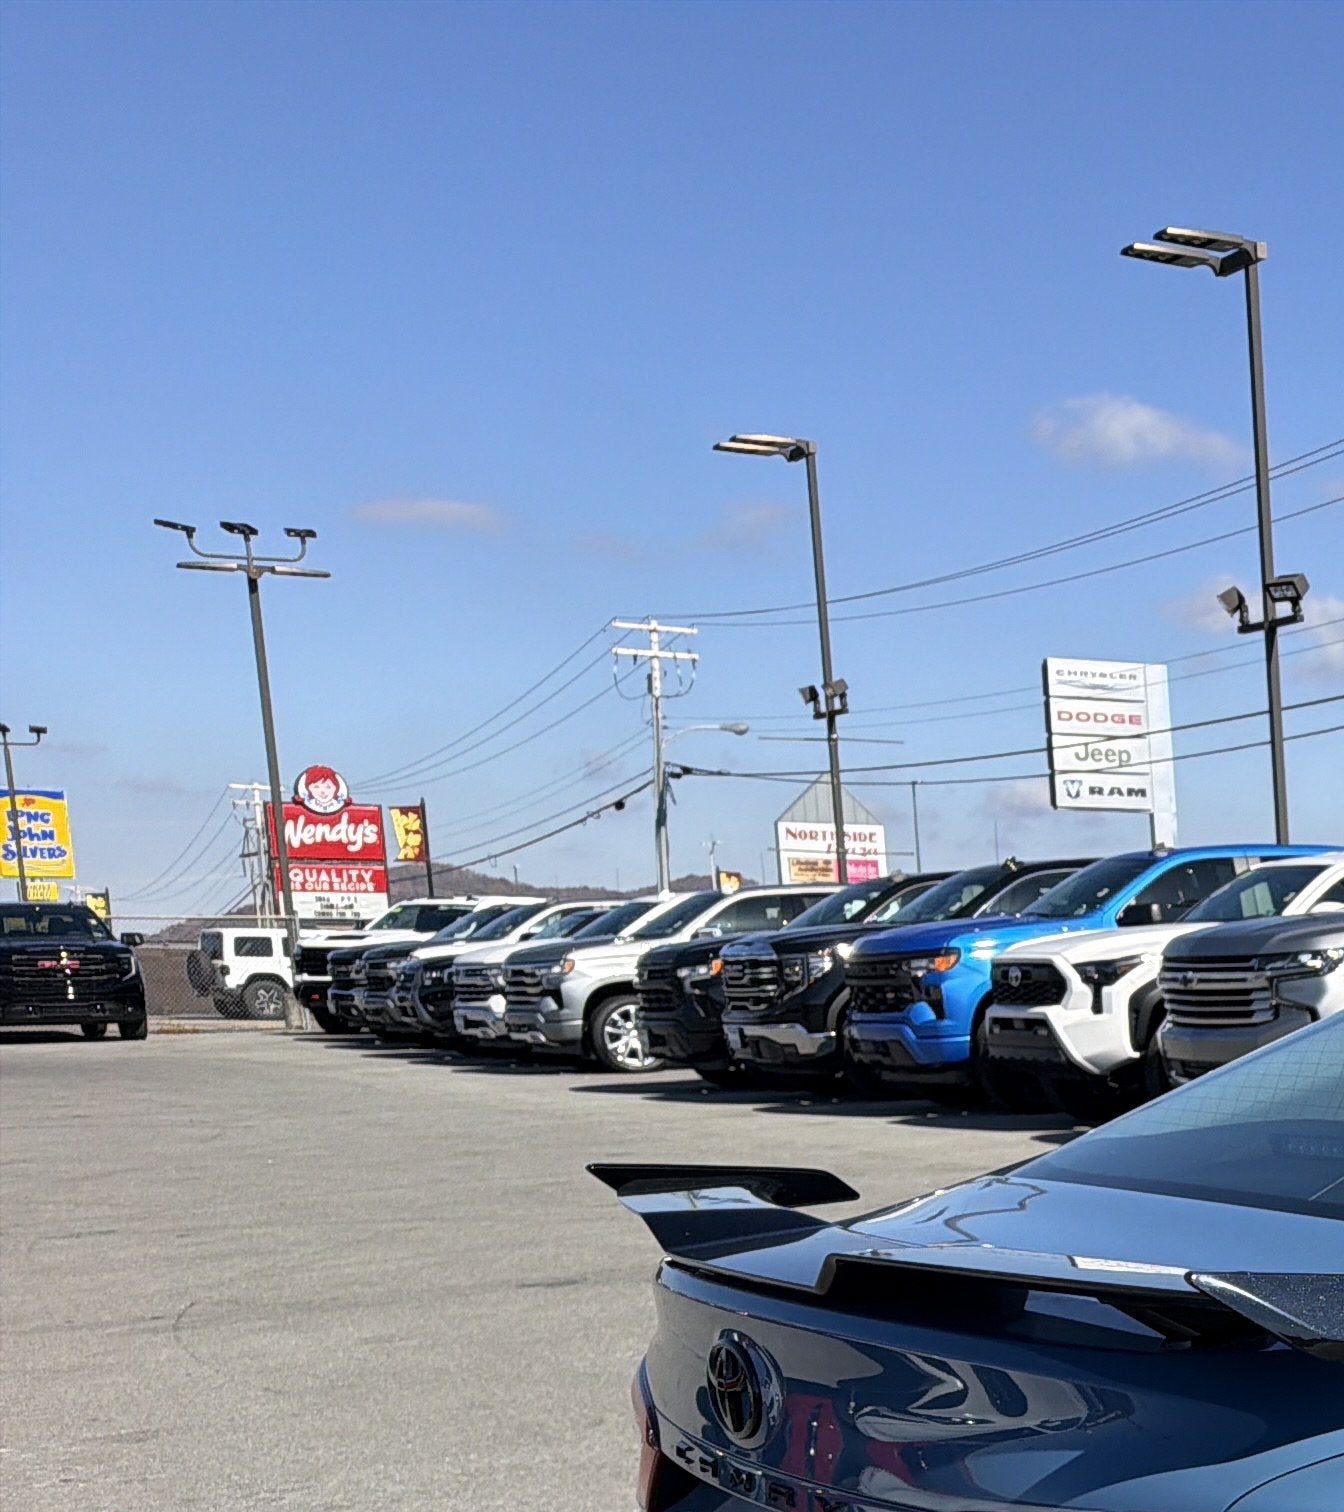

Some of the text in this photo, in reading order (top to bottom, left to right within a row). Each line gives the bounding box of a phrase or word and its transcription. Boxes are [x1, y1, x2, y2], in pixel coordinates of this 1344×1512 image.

[1056, 668, 1137, 681] CHRYSLER
[1057, 710, 1142, 726] DODGE
[1074, 743, 1131, 768] Jeep
[1088, 786, 1147, 798] RAM
[284, 812, 378, 852] Wendy's
[288, 868, 373, 883] QUALITY
[304, 881, 330, 891] OUR
